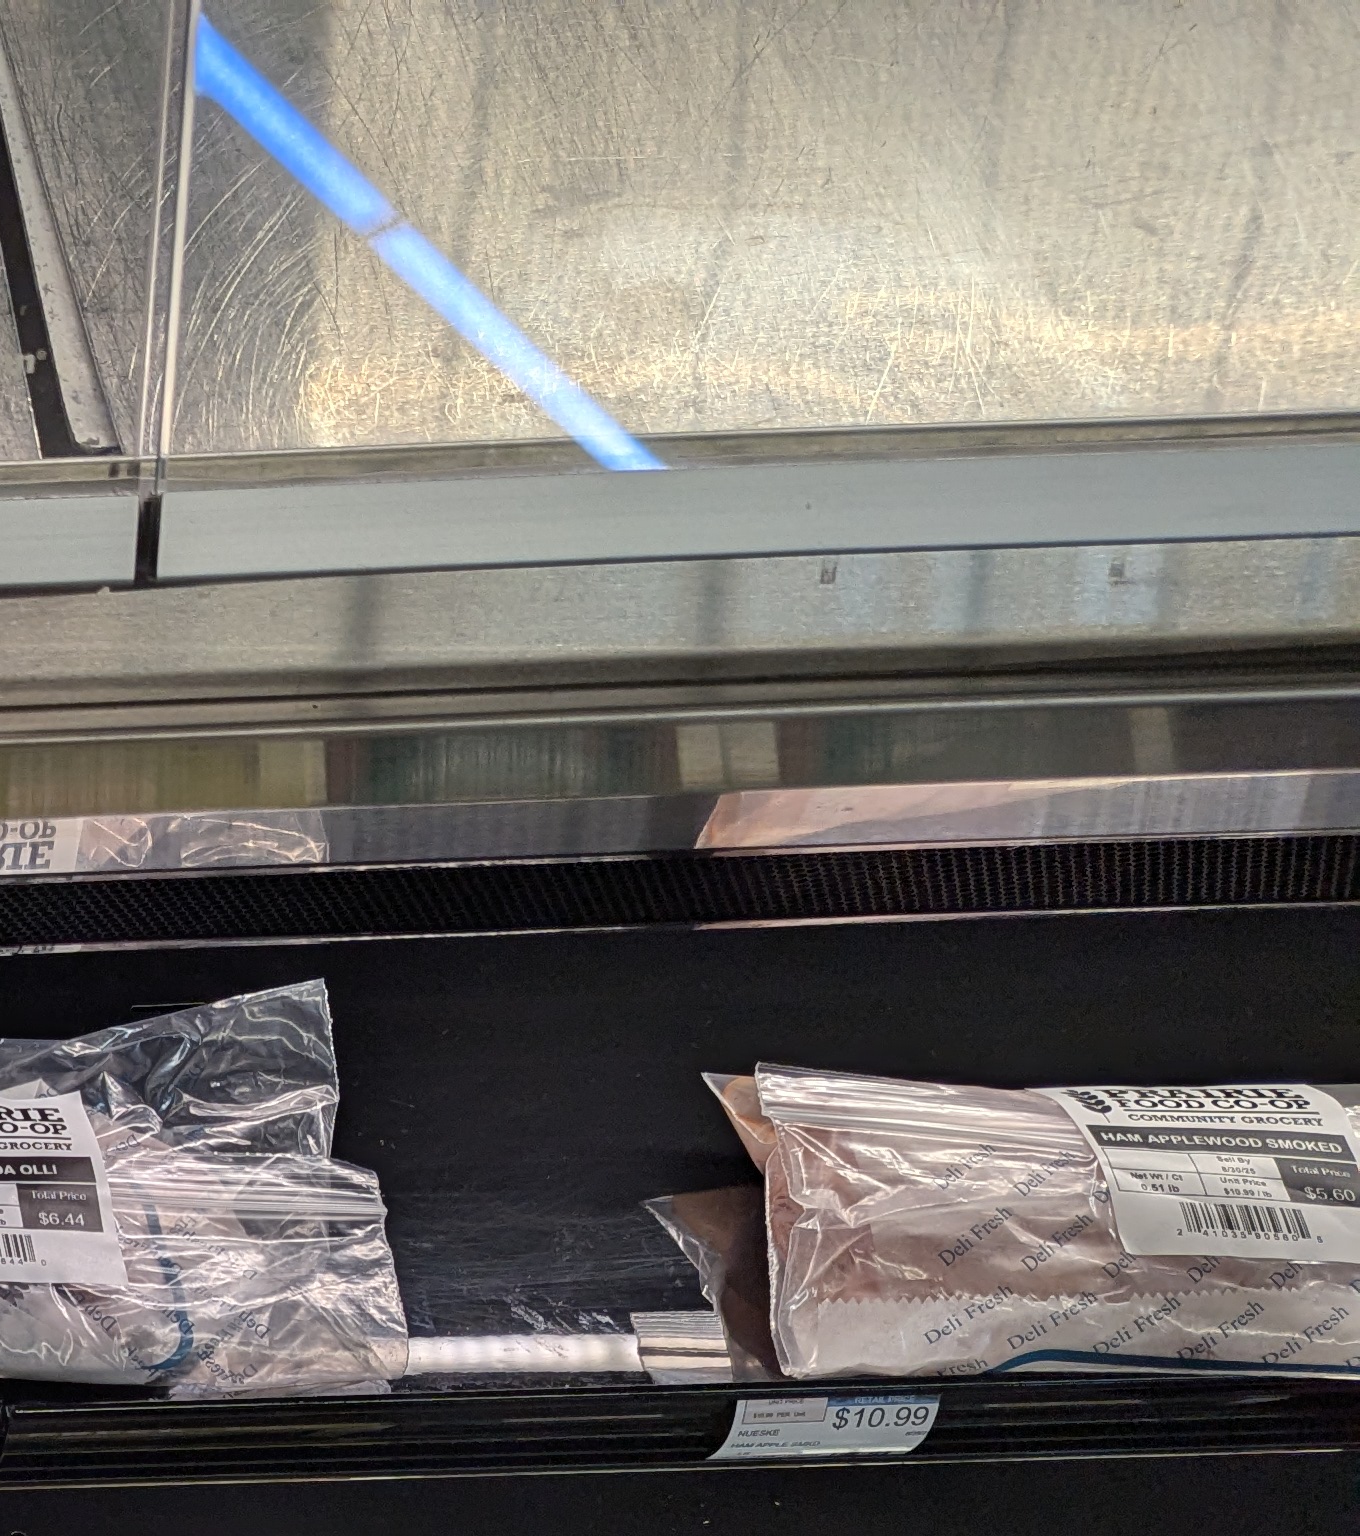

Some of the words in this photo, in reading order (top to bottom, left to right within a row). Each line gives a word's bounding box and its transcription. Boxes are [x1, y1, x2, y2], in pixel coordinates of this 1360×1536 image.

[1095, 1089, 1304, 1099] PRAIRIE
[1119, 1100, 1206, 1110] FOOD
[1210, 1100, 1311, 1109] CO-OP
[1128, 1114, 1236, 1123] COMMUNITY
[1241, 1116, 1323, 1127] GROCERY
[1100, 1132, 1143, 1142] HAM
[1148, 1134, 1262, 1148] APPLEWOOD
[1266, 1138, 1342, 1154] SMOKED
[21, 1164, 57, 1174] OLLI
[1290, 1164, 1318, 1175] Total
[1321, 1167, 1350, 1178] Price
[1141, 1183, 1164, 1192] 0.51
[1304, 1186, 1356, 1202] $5.60
[39, 1212, 84, 1227] $6.44
[938, 1231, 970, 1267] Deli
[970, 1206, 1013, 1242] Fresh
[924, 1316, 963, 1346] Deli
[966, 1283, 1014, 1319] Fresh
[832, 1406, 929, 1430] $10.99
